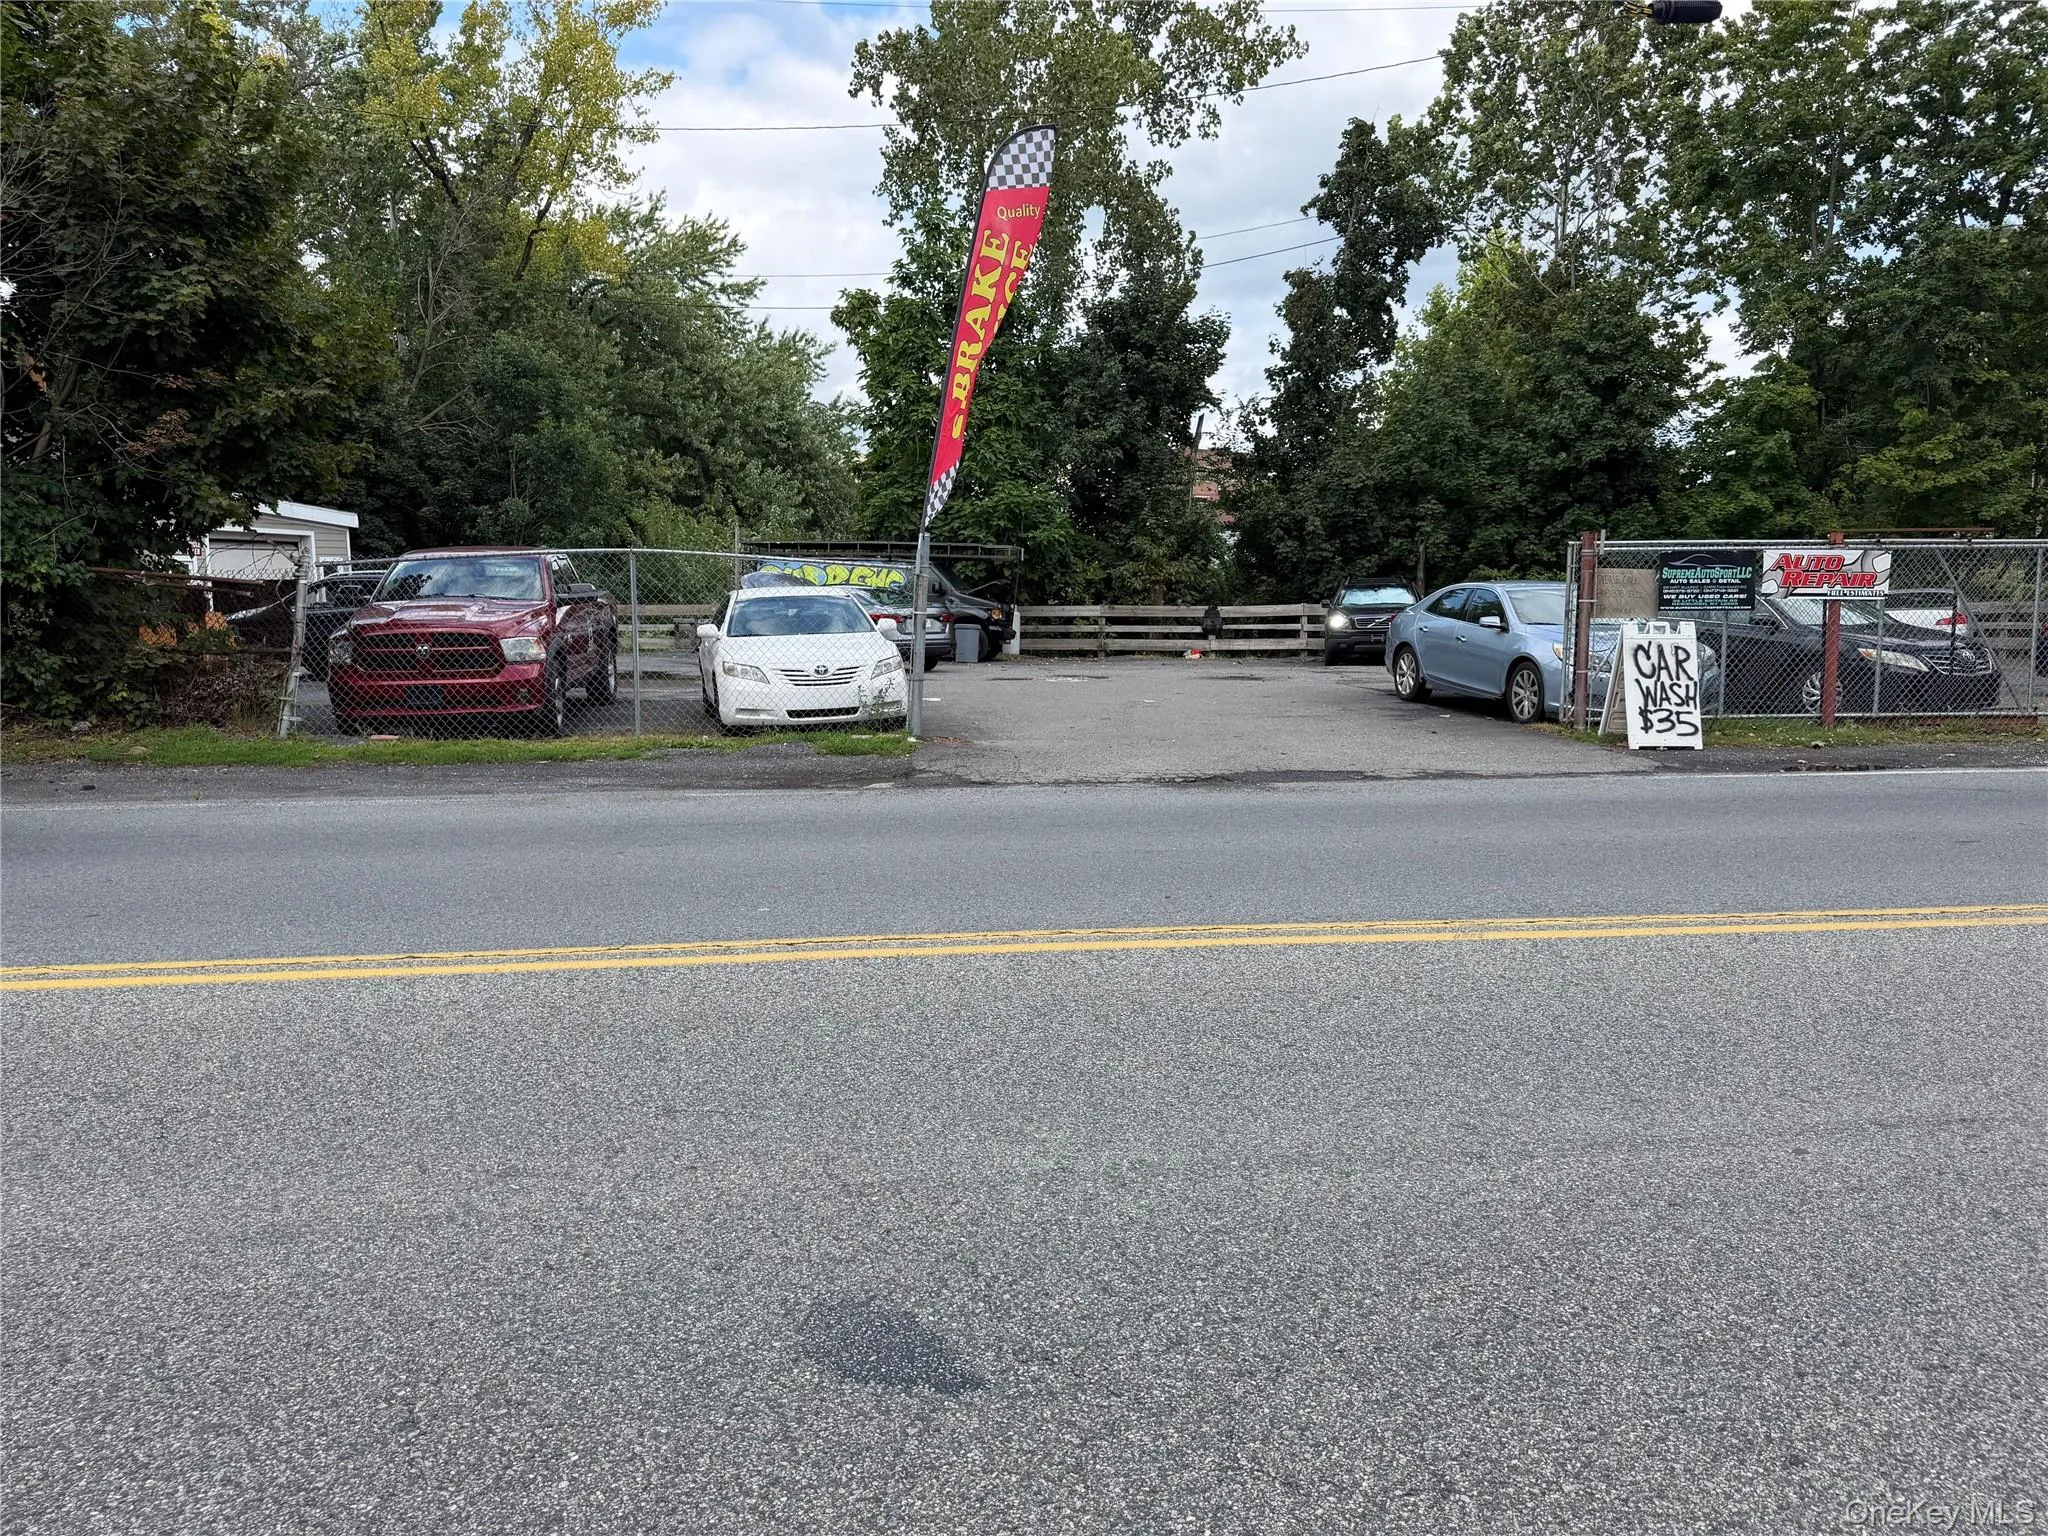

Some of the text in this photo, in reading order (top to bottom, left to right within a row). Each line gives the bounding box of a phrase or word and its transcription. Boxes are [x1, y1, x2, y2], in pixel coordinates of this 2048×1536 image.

[996, 203, 1041, 221] Quality
[952, 229, 1010, 404] BRAKE
[1769, 552, 1846, 572] AUTO
[1780, 570, 1878, 589] REPAIR
[1633, 640, 1695, 681] CAR
[1634, 678, 1698, 711] WASH
[1638, 706, 1699, 737] $35
